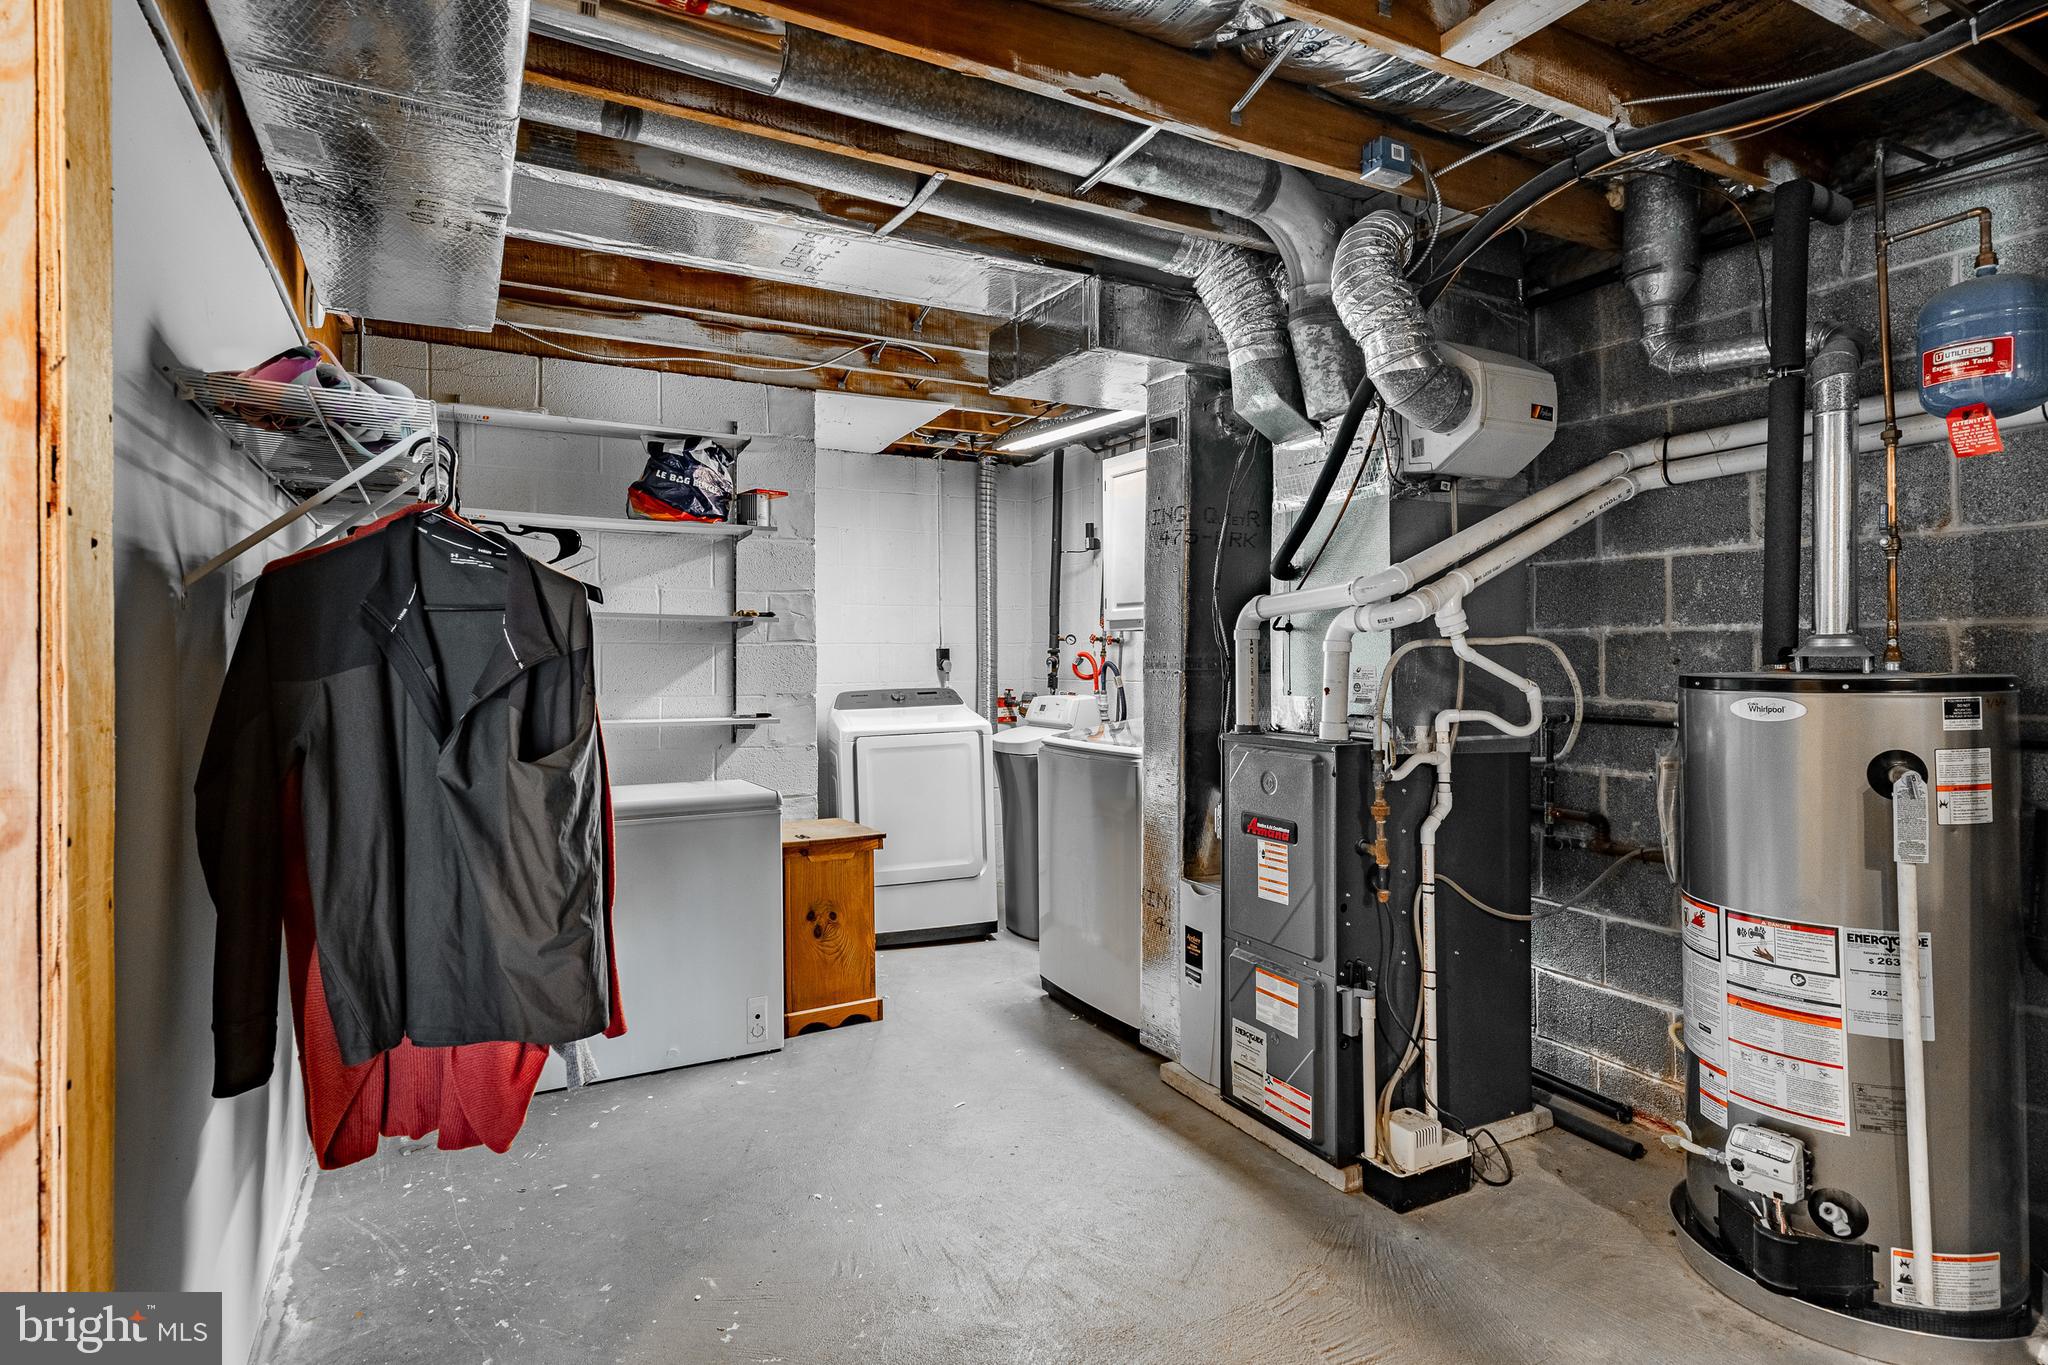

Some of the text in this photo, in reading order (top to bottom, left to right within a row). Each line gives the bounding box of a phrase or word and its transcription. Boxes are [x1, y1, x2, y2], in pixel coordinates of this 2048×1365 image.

[1945, 346, 1986, 359] UTILITECH
[1932, 360, 1970, 373] Expansion
[1972, 357, 1994, 365] Tank
[655, 469, 667, 479] LE
[669, 473, 691, 485] BAG
[1748, 705, 1785, 715] Whirlpool
[1247, 817, 1290, 842] Amana
[1767, 921, 1792, 930] DANGER
[1877, 957, 1901, 967] 263
[1871, 989, 1889, 997] 242
